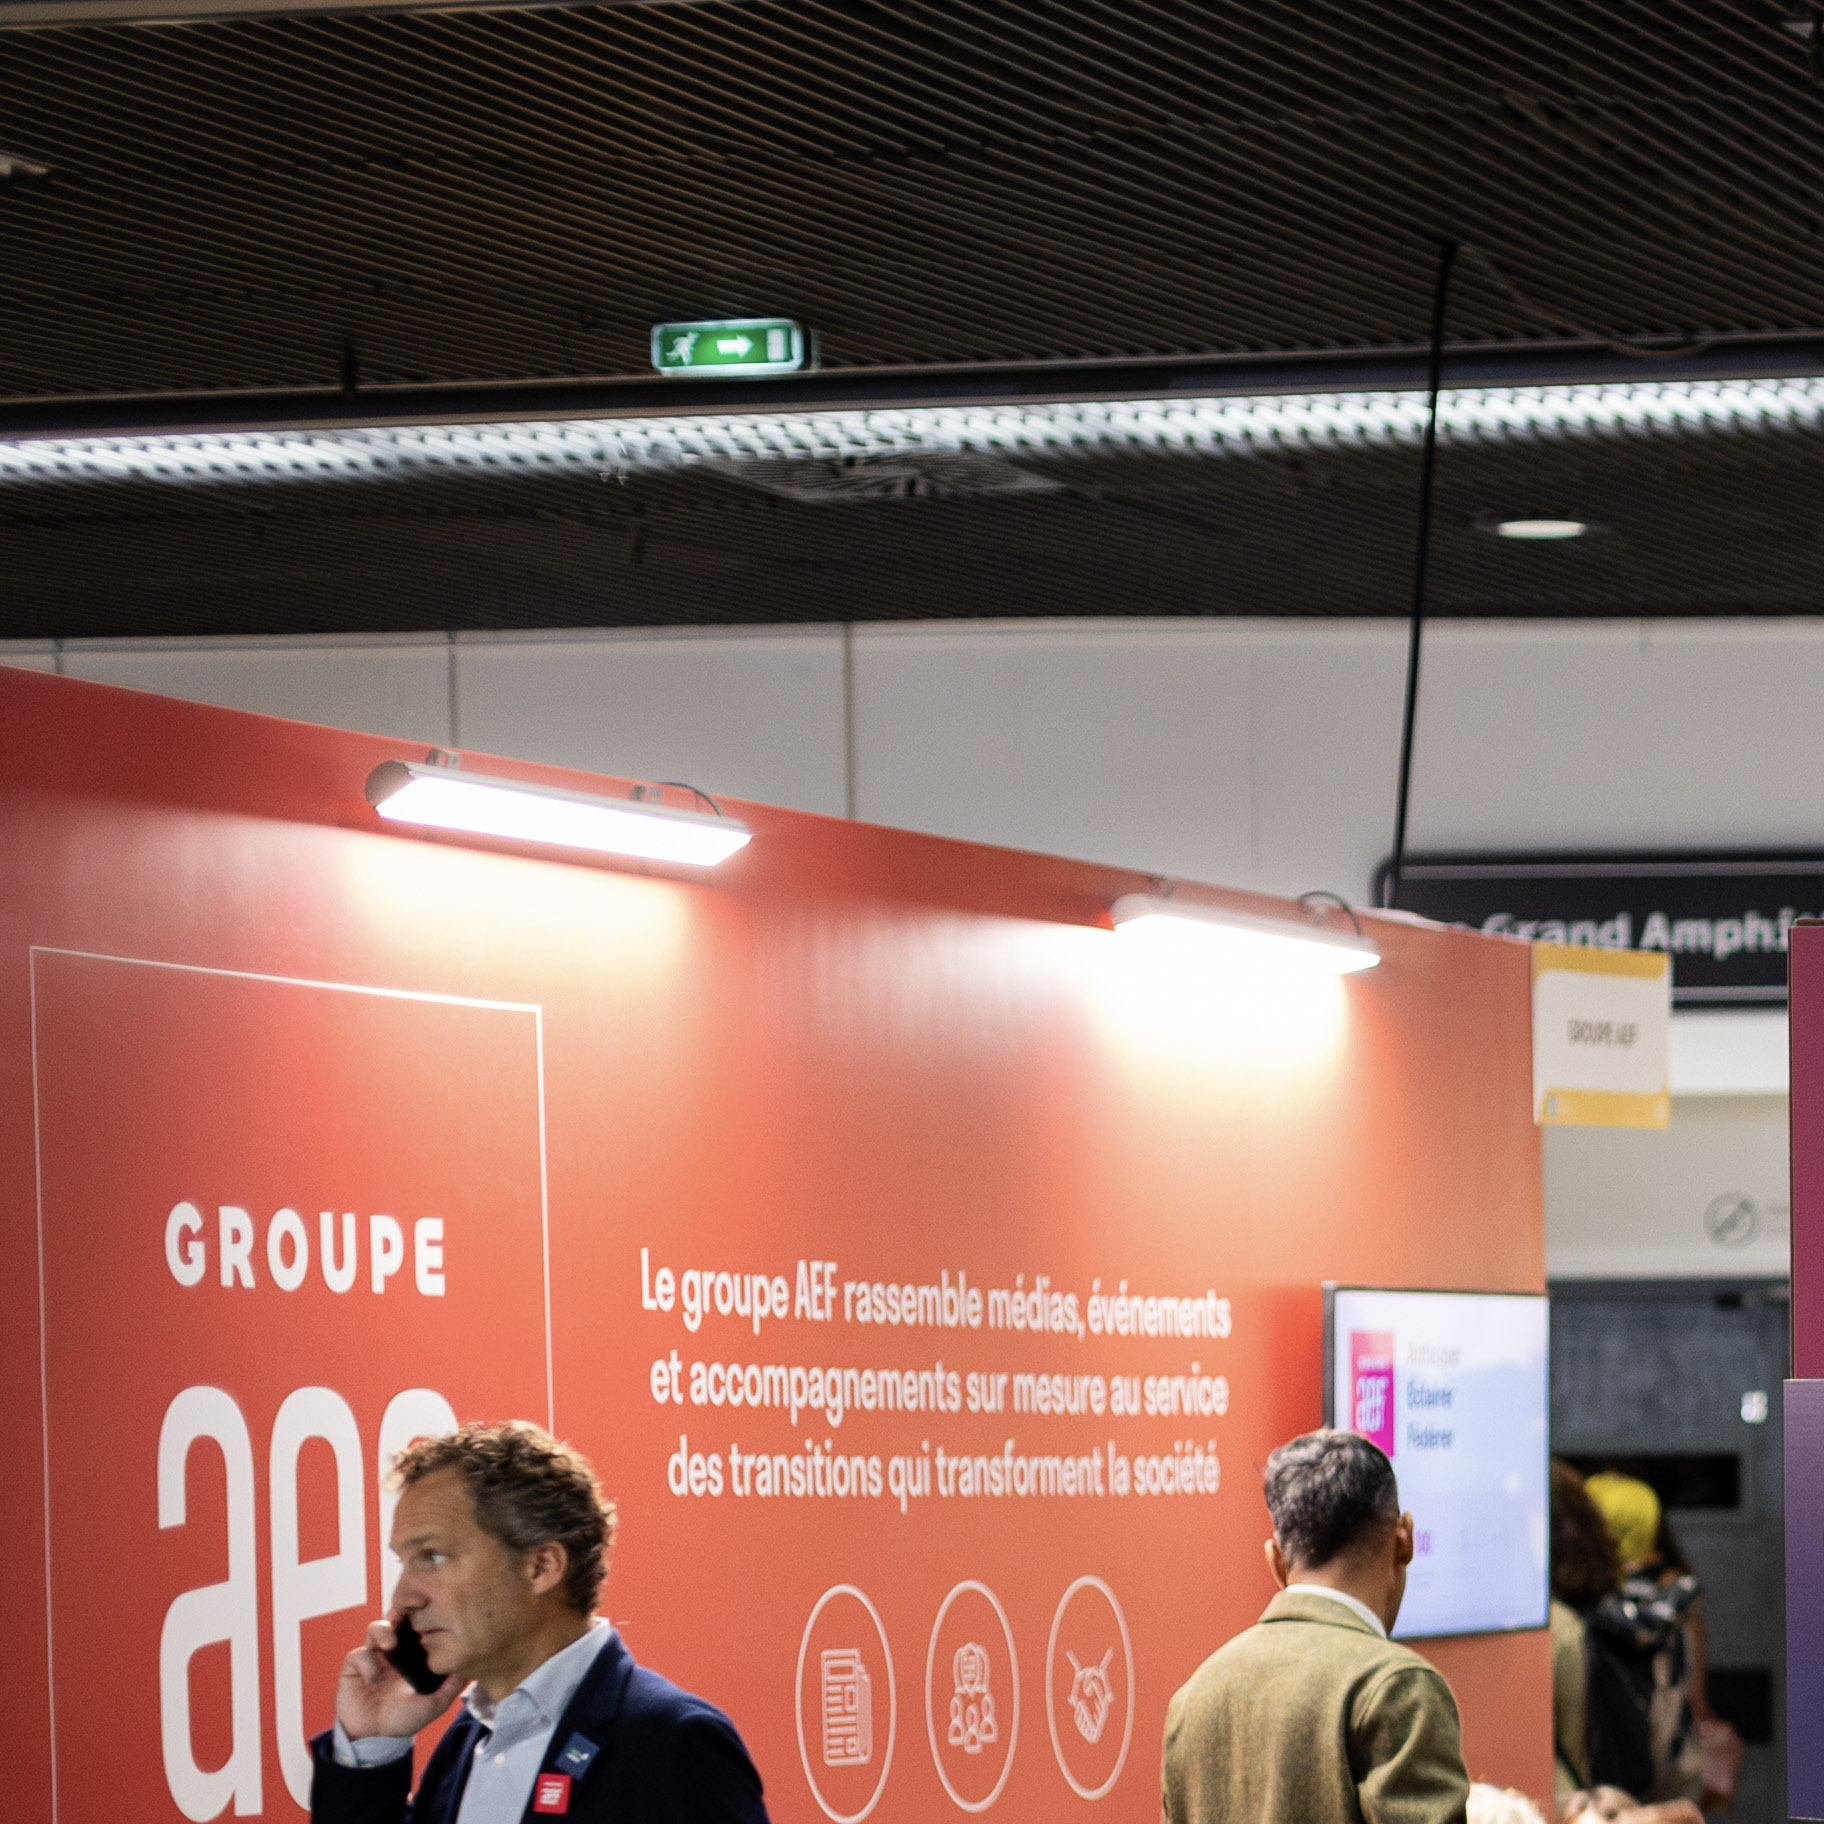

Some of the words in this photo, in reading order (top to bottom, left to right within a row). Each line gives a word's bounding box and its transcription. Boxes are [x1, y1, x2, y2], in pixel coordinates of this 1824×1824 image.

[1483, 911, 1631, 950] Grand
[165, 1202, 446, 1296] GROUPE
[641, 1248, 675, 1312] Le
[681, 1269, 789, 1335] groupe
[794, 1260, 838, 1321] AEF
[844, 1270, 982, 1328] rassemble
[988, 1274, 1085, 1340] médias,
[1088, 1279, 1232, 1338] événements
[650, 1350, 683, 1405] et
[690, 1362, 962, 1428] accompagnements
[966, 1371, 1008, 1413] sur
[1013, 1373, 1105, 1416] mesure
[1111, 1375, 1143, 1416] au
[1144, 1362, 1229, 1416] service
[667, 1435, 724, 1497] des
[729, 1439, 883, 1497] transitions
[888, 1440, 931, 1514] qui
[935, 1439, 1103, 1497] transforment
[1107, 1440, 1131, 1496] la
[1134, 1438, 1220, 1496] société
